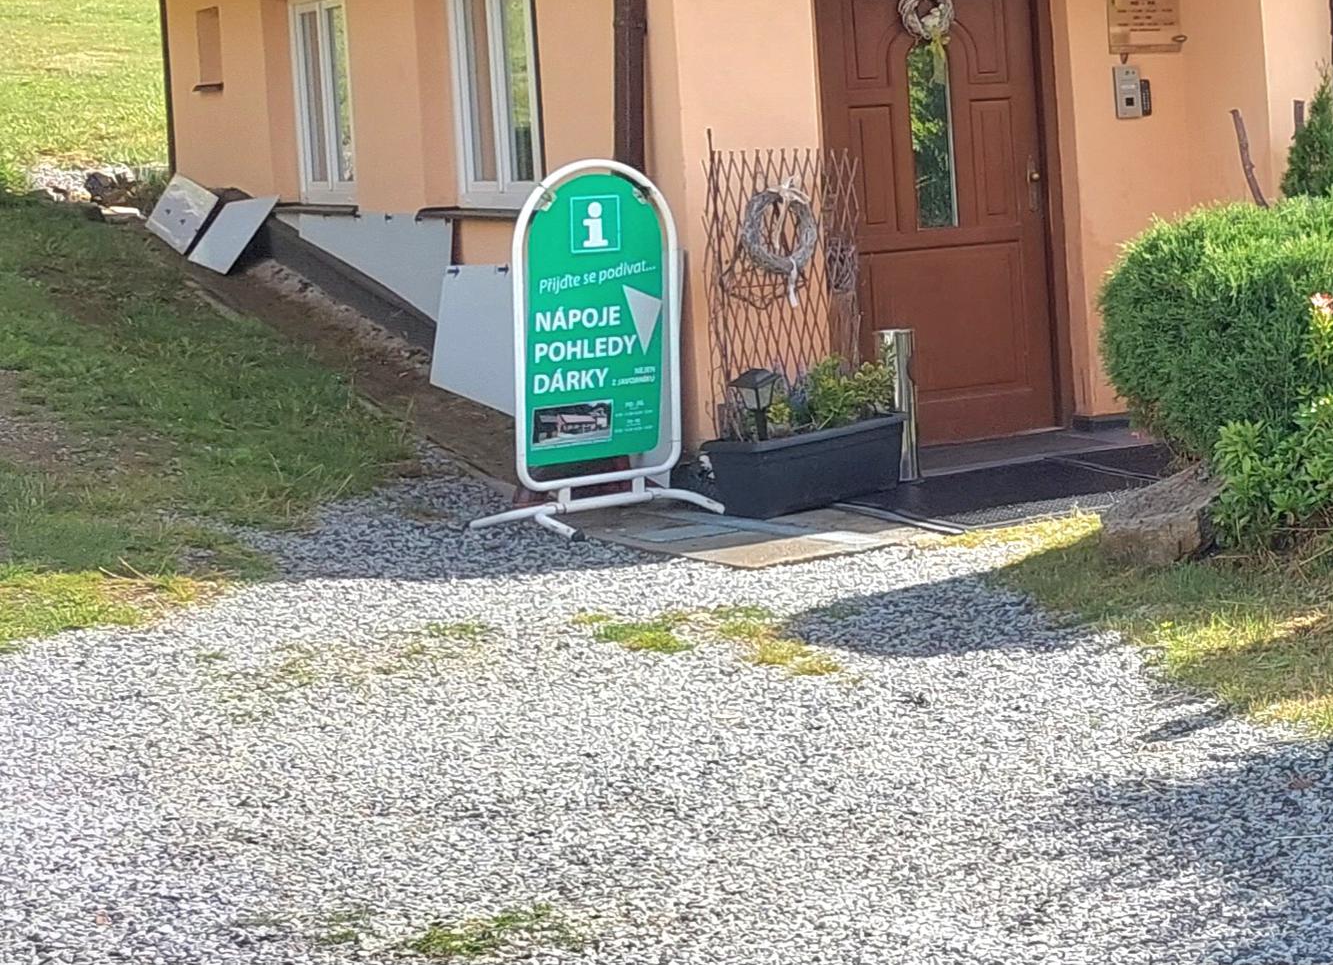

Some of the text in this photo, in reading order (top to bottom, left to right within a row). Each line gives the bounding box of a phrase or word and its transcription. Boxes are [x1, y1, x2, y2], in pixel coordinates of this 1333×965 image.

[540, 274, 580, 294] Přijďte
[583, 271, 596, 285] se
[535, 306, 620, 332] NÁPOJE
[534, 335, 637, 363] POHLEDY
[533, 368, 609, 394] DÁRKY
